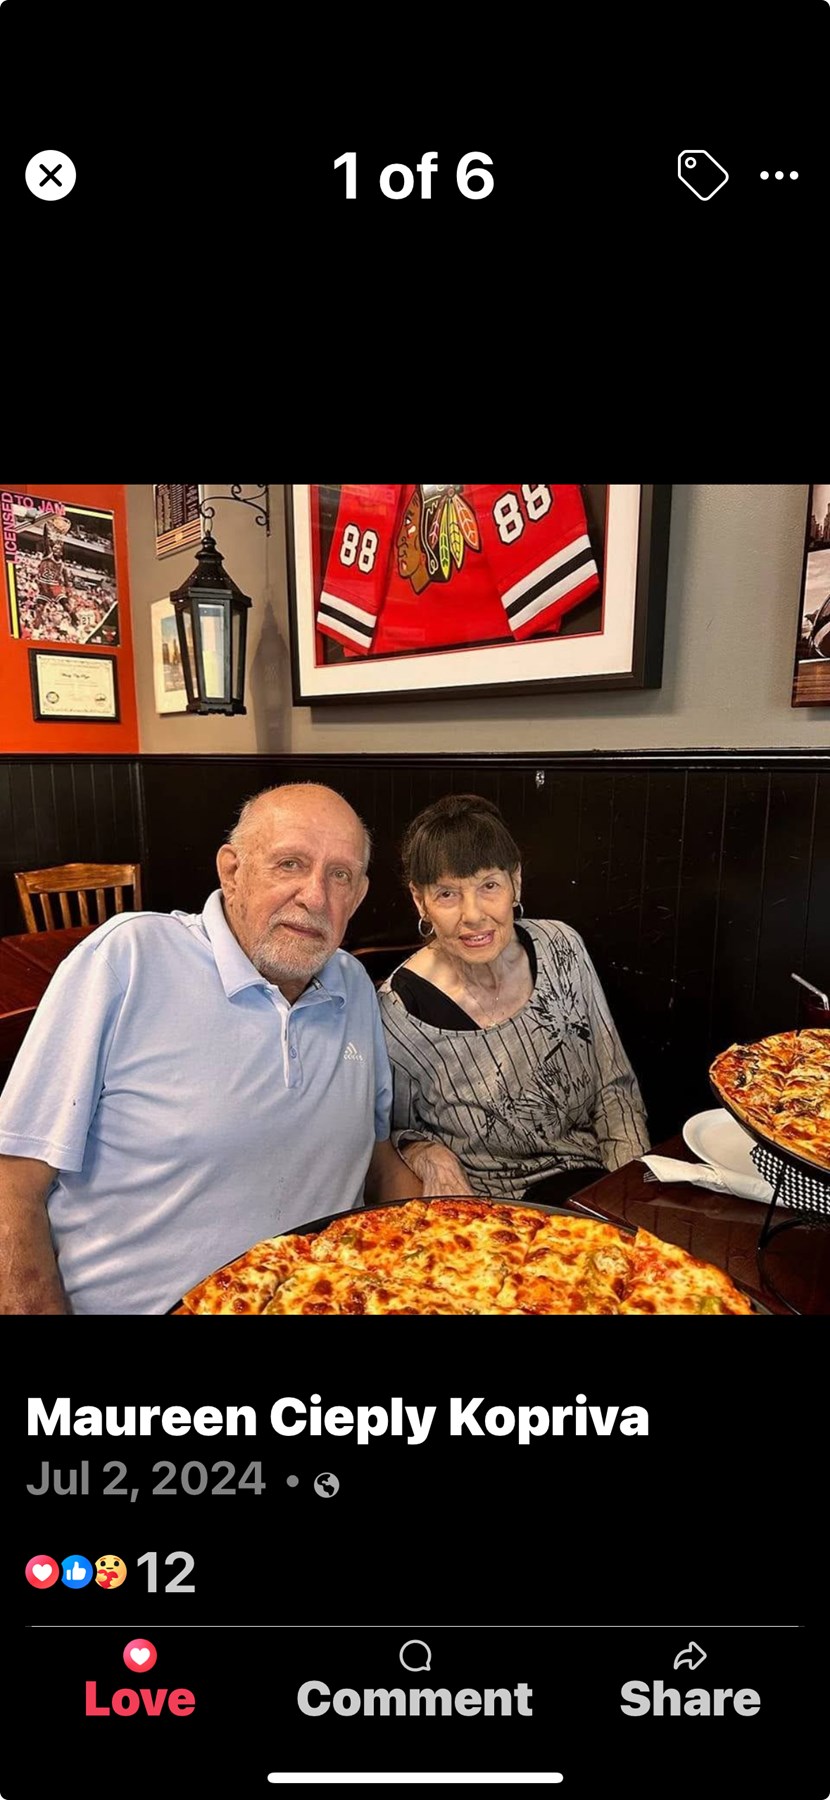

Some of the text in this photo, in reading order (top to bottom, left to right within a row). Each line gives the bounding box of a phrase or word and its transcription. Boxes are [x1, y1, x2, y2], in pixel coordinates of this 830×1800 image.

[1, 492, 20, 564] LICENSED
[14, 494, 66, 515] TO JAM
[492, 484, 553, 545] 88
[339, 522, 379, 575] 88
